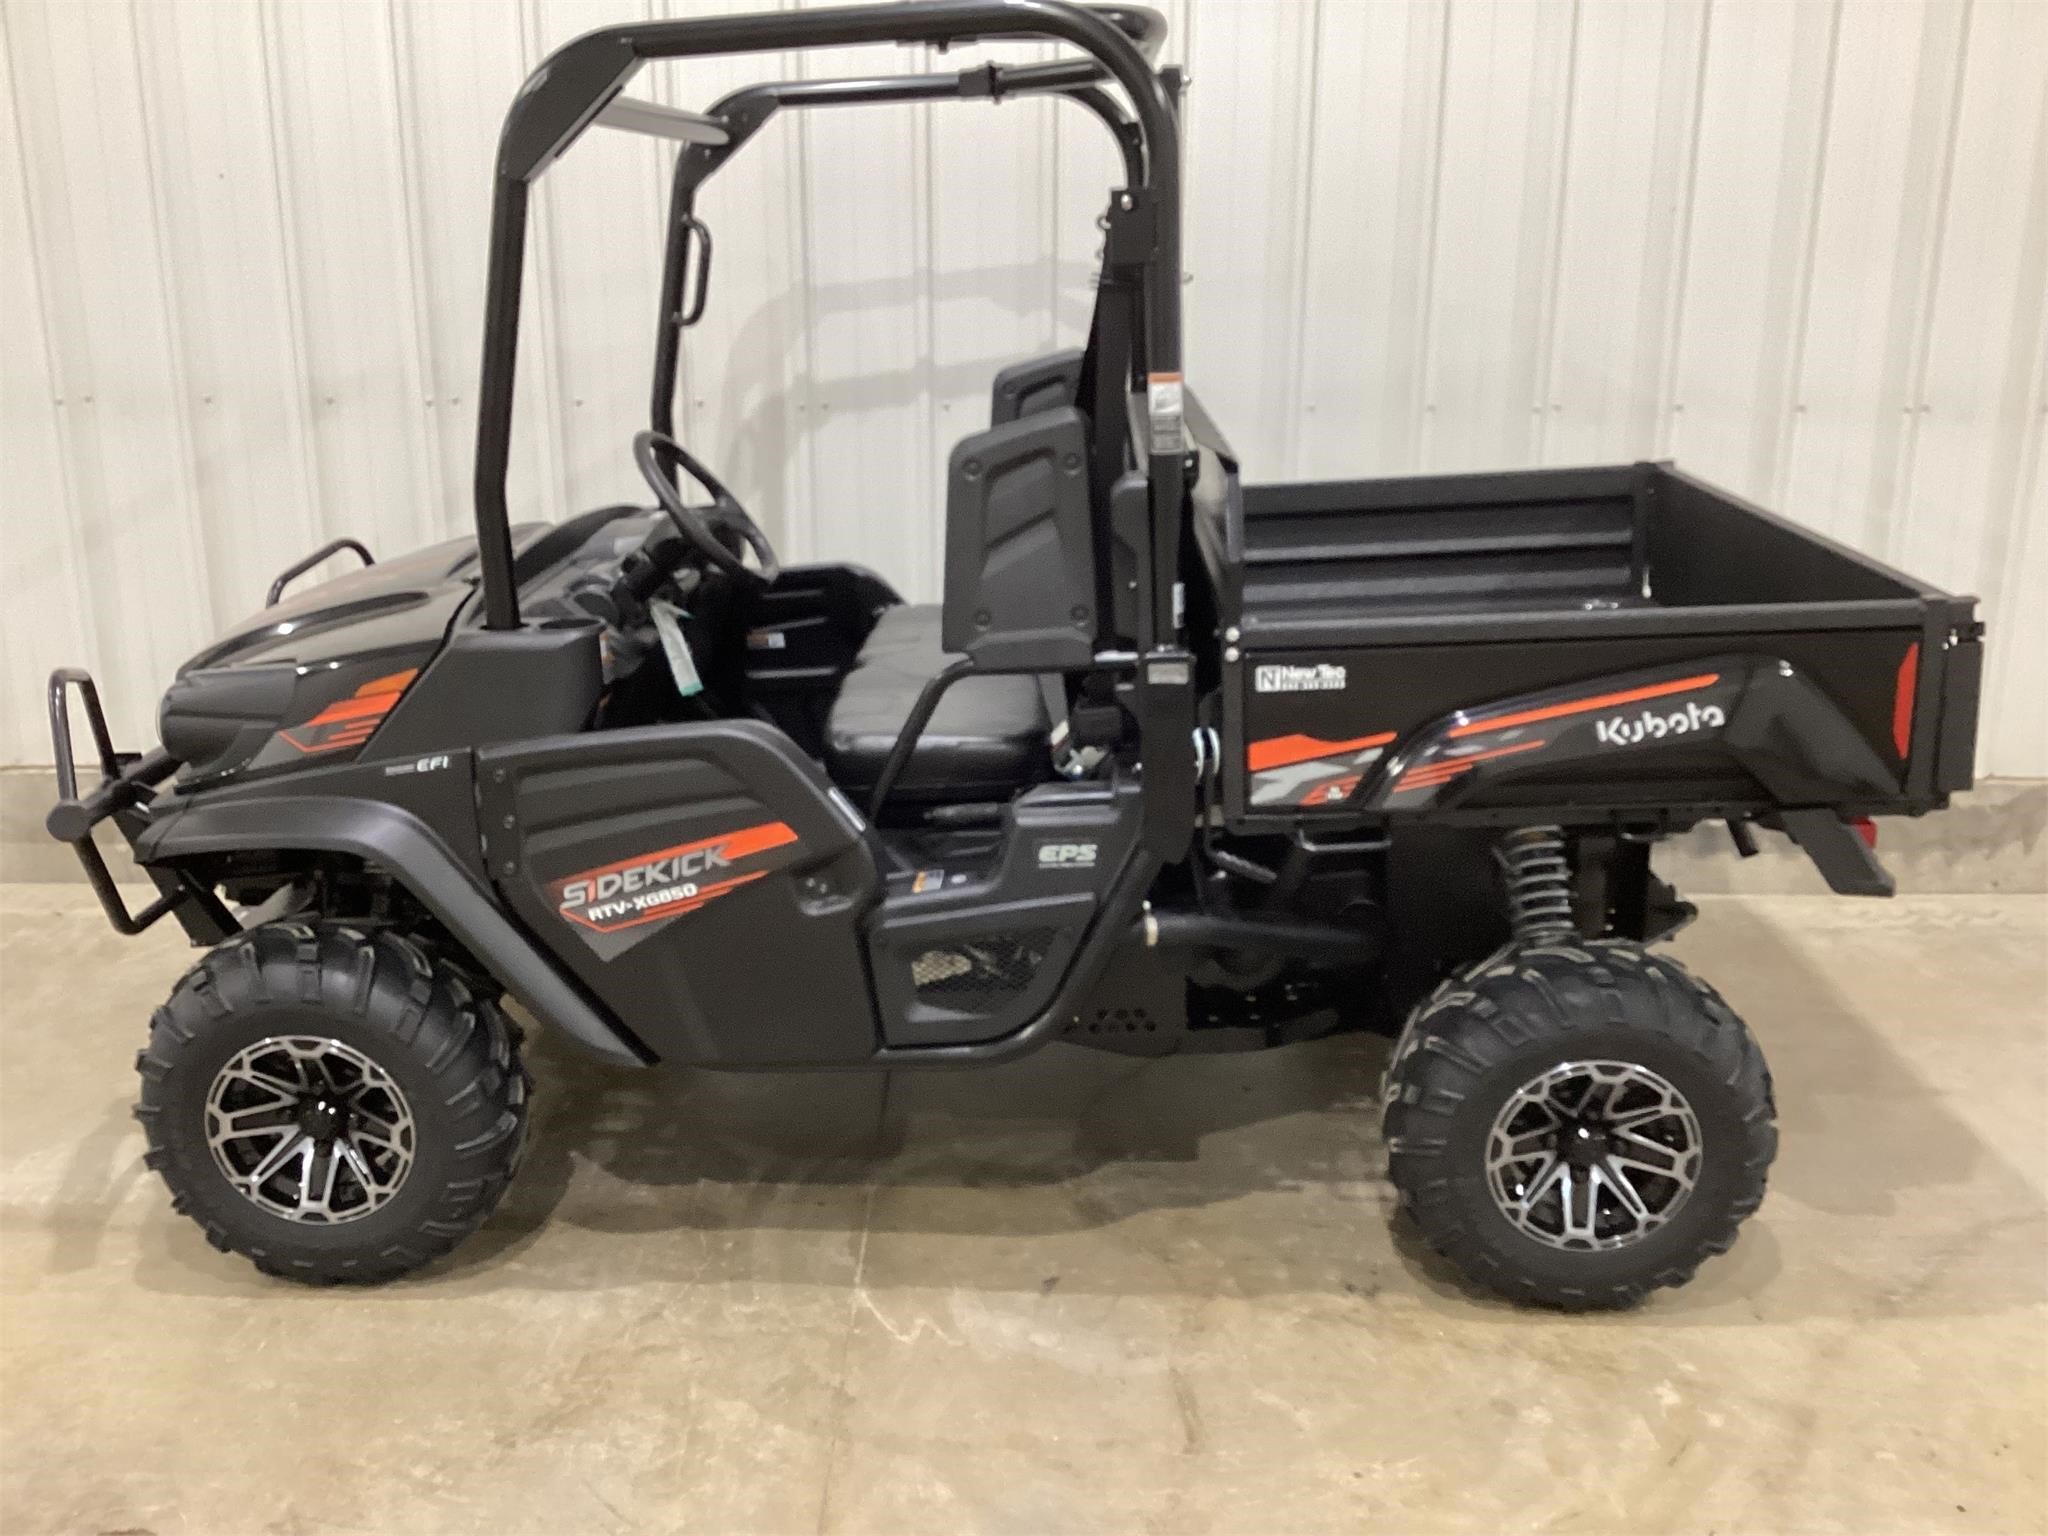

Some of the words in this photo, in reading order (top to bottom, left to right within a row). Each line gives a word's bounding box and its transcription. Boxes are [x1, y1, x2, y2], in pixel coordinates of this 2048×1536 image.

[1596, 702, 1725, 746] Kubota
[417, 755, 449, 772] EFI
[1039, 844, 1098, 862] EPS
[560, 841, 733, 910] SIDEKICK
[588, 882, 699, 921] RTV-XG850
